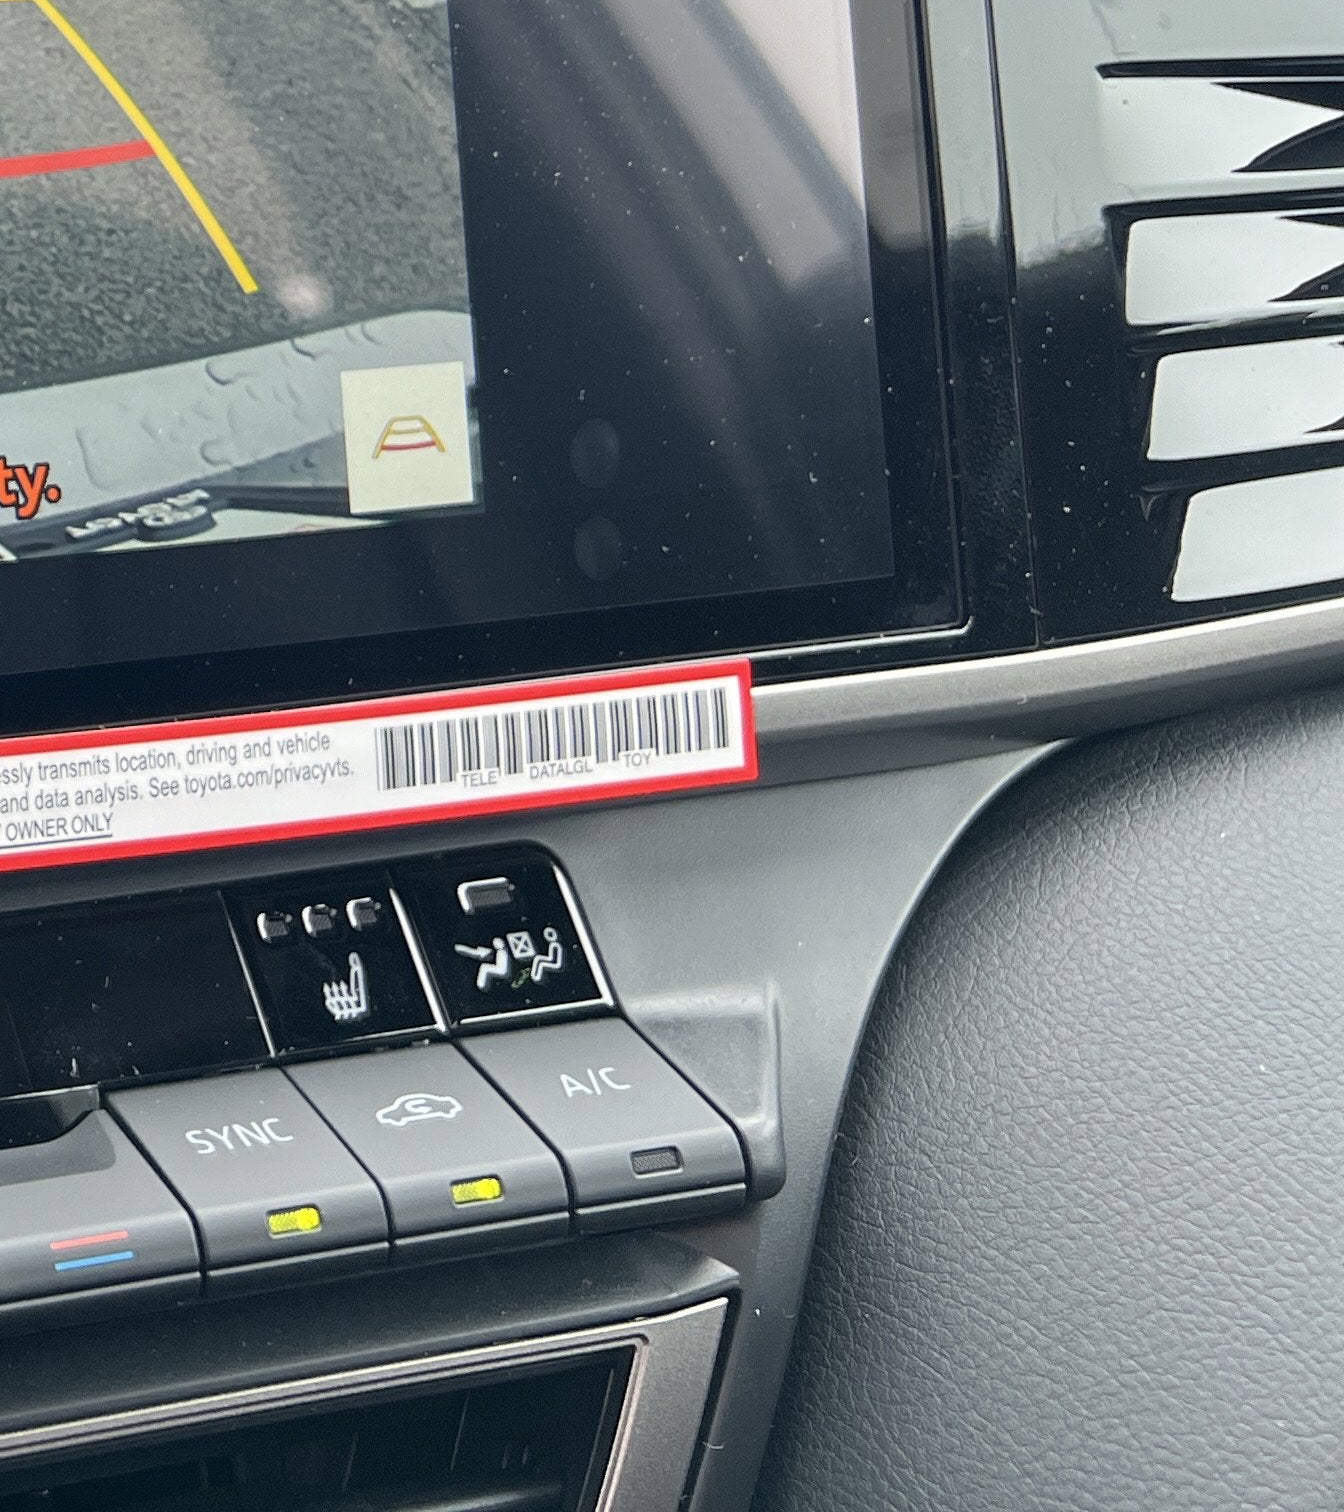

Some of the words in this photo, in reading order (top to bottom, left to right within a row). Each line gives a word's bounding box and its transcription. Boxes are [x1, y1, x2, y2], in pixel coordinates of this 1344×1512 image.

[38, 755, 110, 780] transmits
[115, 748, 181, 773] location,
[186, 741, 238, 767] driving
[243, 737, 271, 760] and
[277, 731, 330, 755] vehicle
[460, 771, 498, 789] TELE
[529, 758, 593, 781] DATALGL
[622, 752, 654, 769] TOY
[0, 791, 29, 814] and
[34, 786, 69, 811] data
[74, 782, 143, 808] analysis.
[149, 775, 179, 798] See
[184, 759, 354, 799] toyota.com/privacyvts.
[5, 816, 67, 841] OWNER
[71, 812, 113, 834] ONLY
[559, 1066, 632, 1098] A/C
[185, 1118, 293, 1156] SYNC
